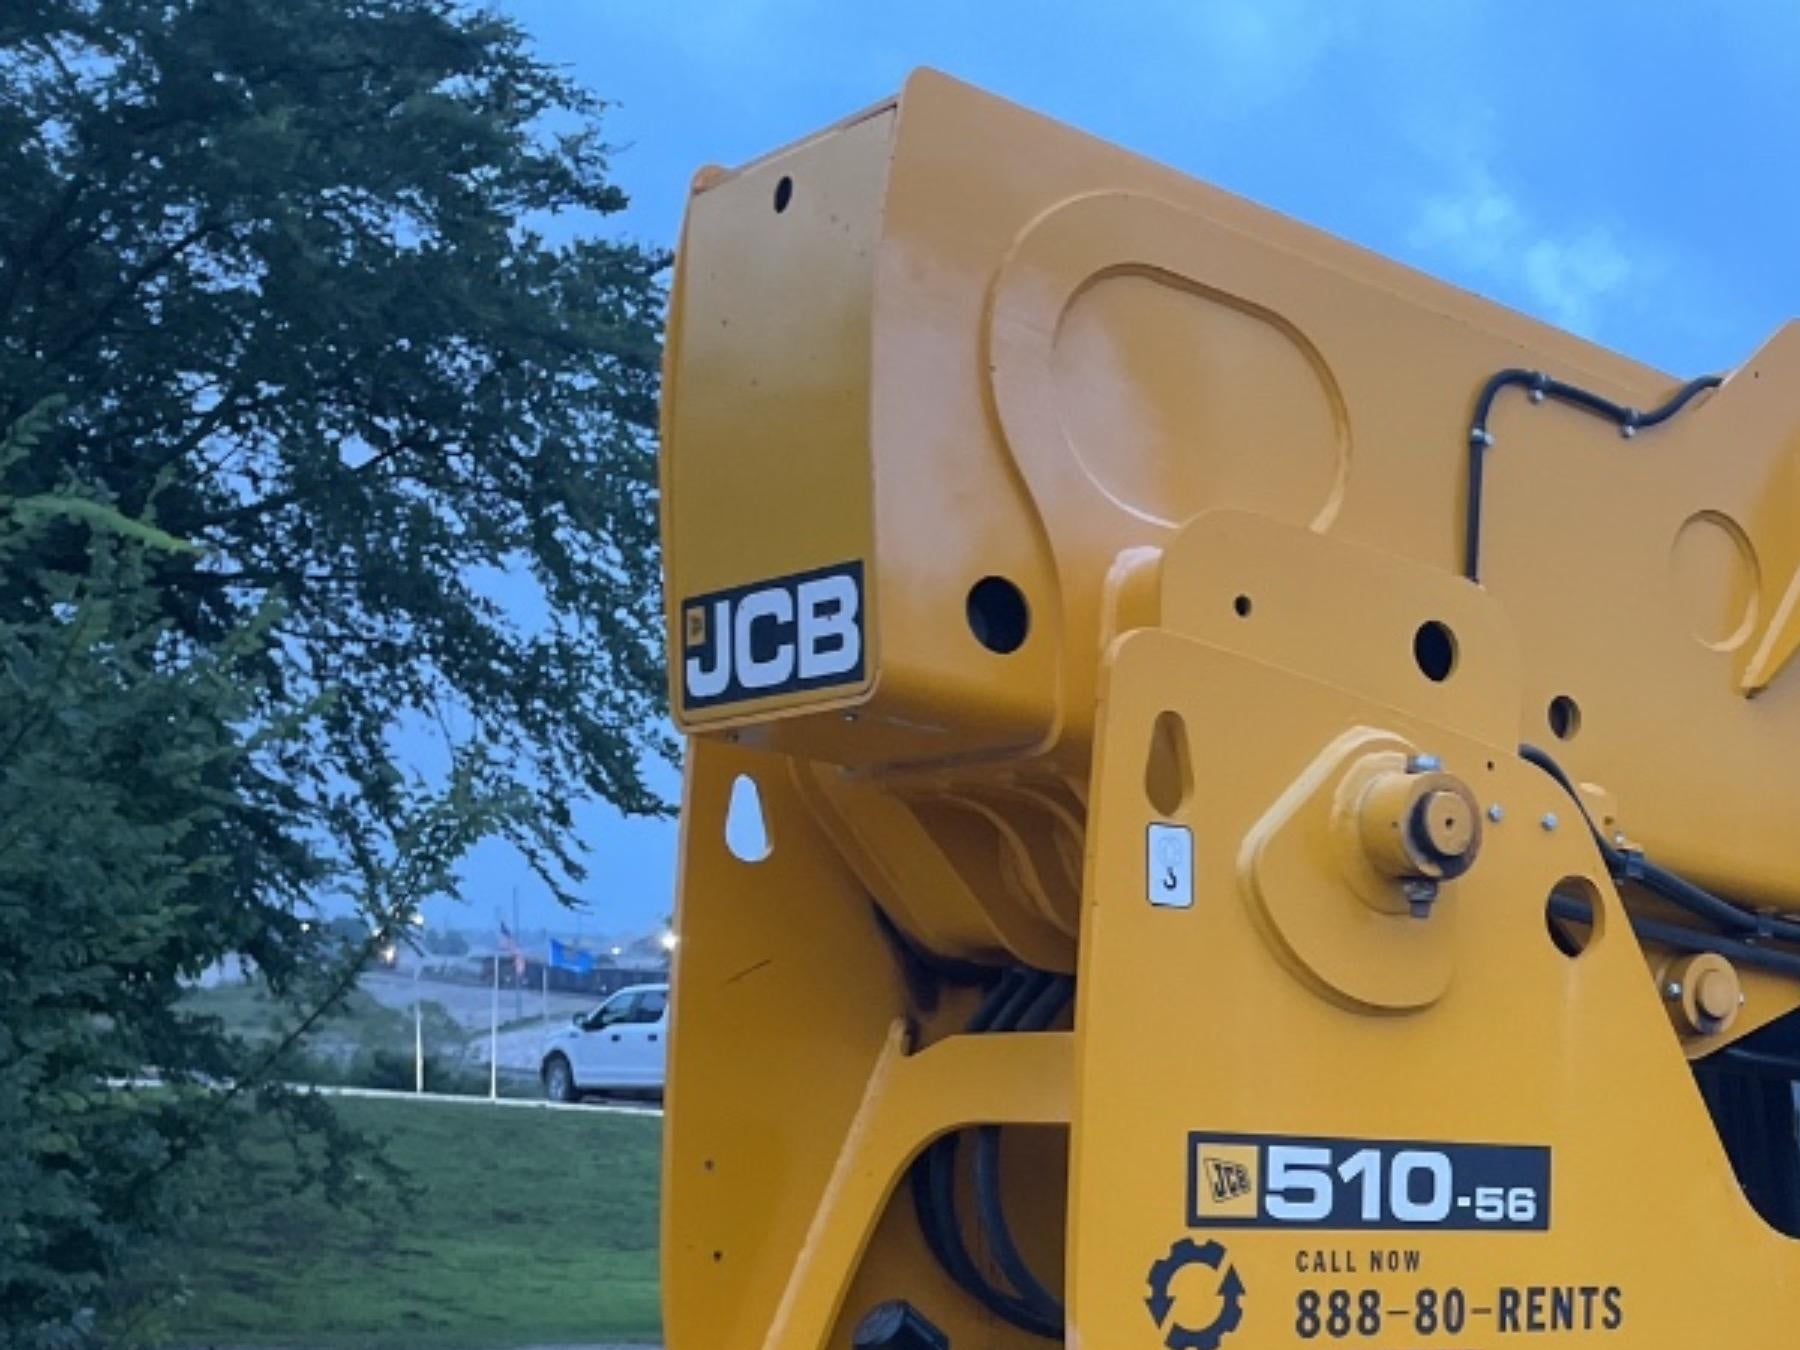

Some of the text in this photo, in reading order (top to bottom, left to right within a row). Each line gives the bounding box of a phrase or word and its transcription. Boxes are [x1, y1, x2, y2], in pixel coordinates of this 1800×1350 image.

[686, 575, 861, 697] JCB
[1296, 1250, 1421, 1273] CALL NOW
[1296, 1286, 1623, 1339] 888-80-RENTS
